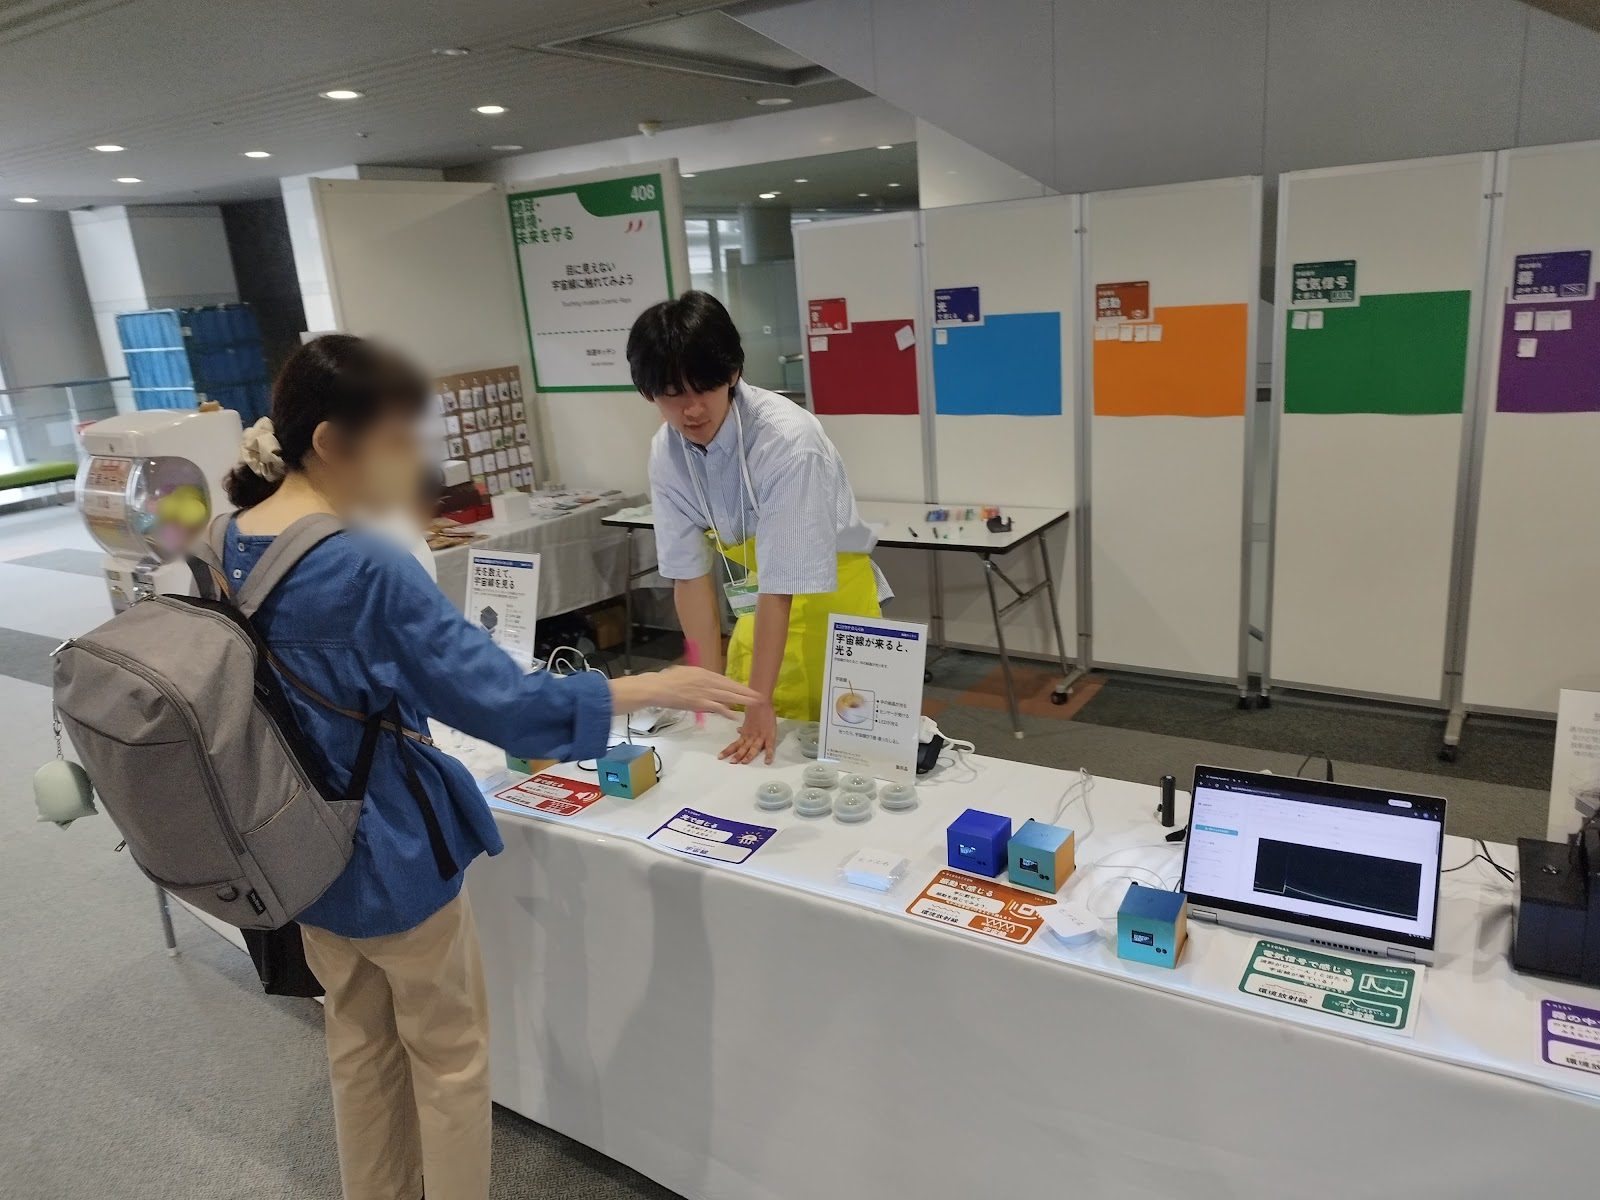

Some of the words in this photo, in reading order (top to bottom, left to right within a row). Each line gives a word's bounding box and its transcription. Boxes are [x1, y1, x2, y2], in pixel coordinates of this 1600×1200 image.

[630, 185, 655, 201] 408
[516, 226, 574, 246] 未来を守る
[565, 262, 616, 276] 目に見えない
[551, 274, 634, 292] 宇宙線に触れてみよう
[474, 566, 513, 579] 光を数えて、
[473, 577, 515, 590] 宇宙線を見る
[834, 645, 853, 657] 光る
[835, 633, 909, 653] 宇宙線が来ると、
[938, 877, 993, 897] 振動で感じる
[1266, 942, 1290, 953] SIGNAL
[1262, 949, 1353, 976] 電気信号で感じる
